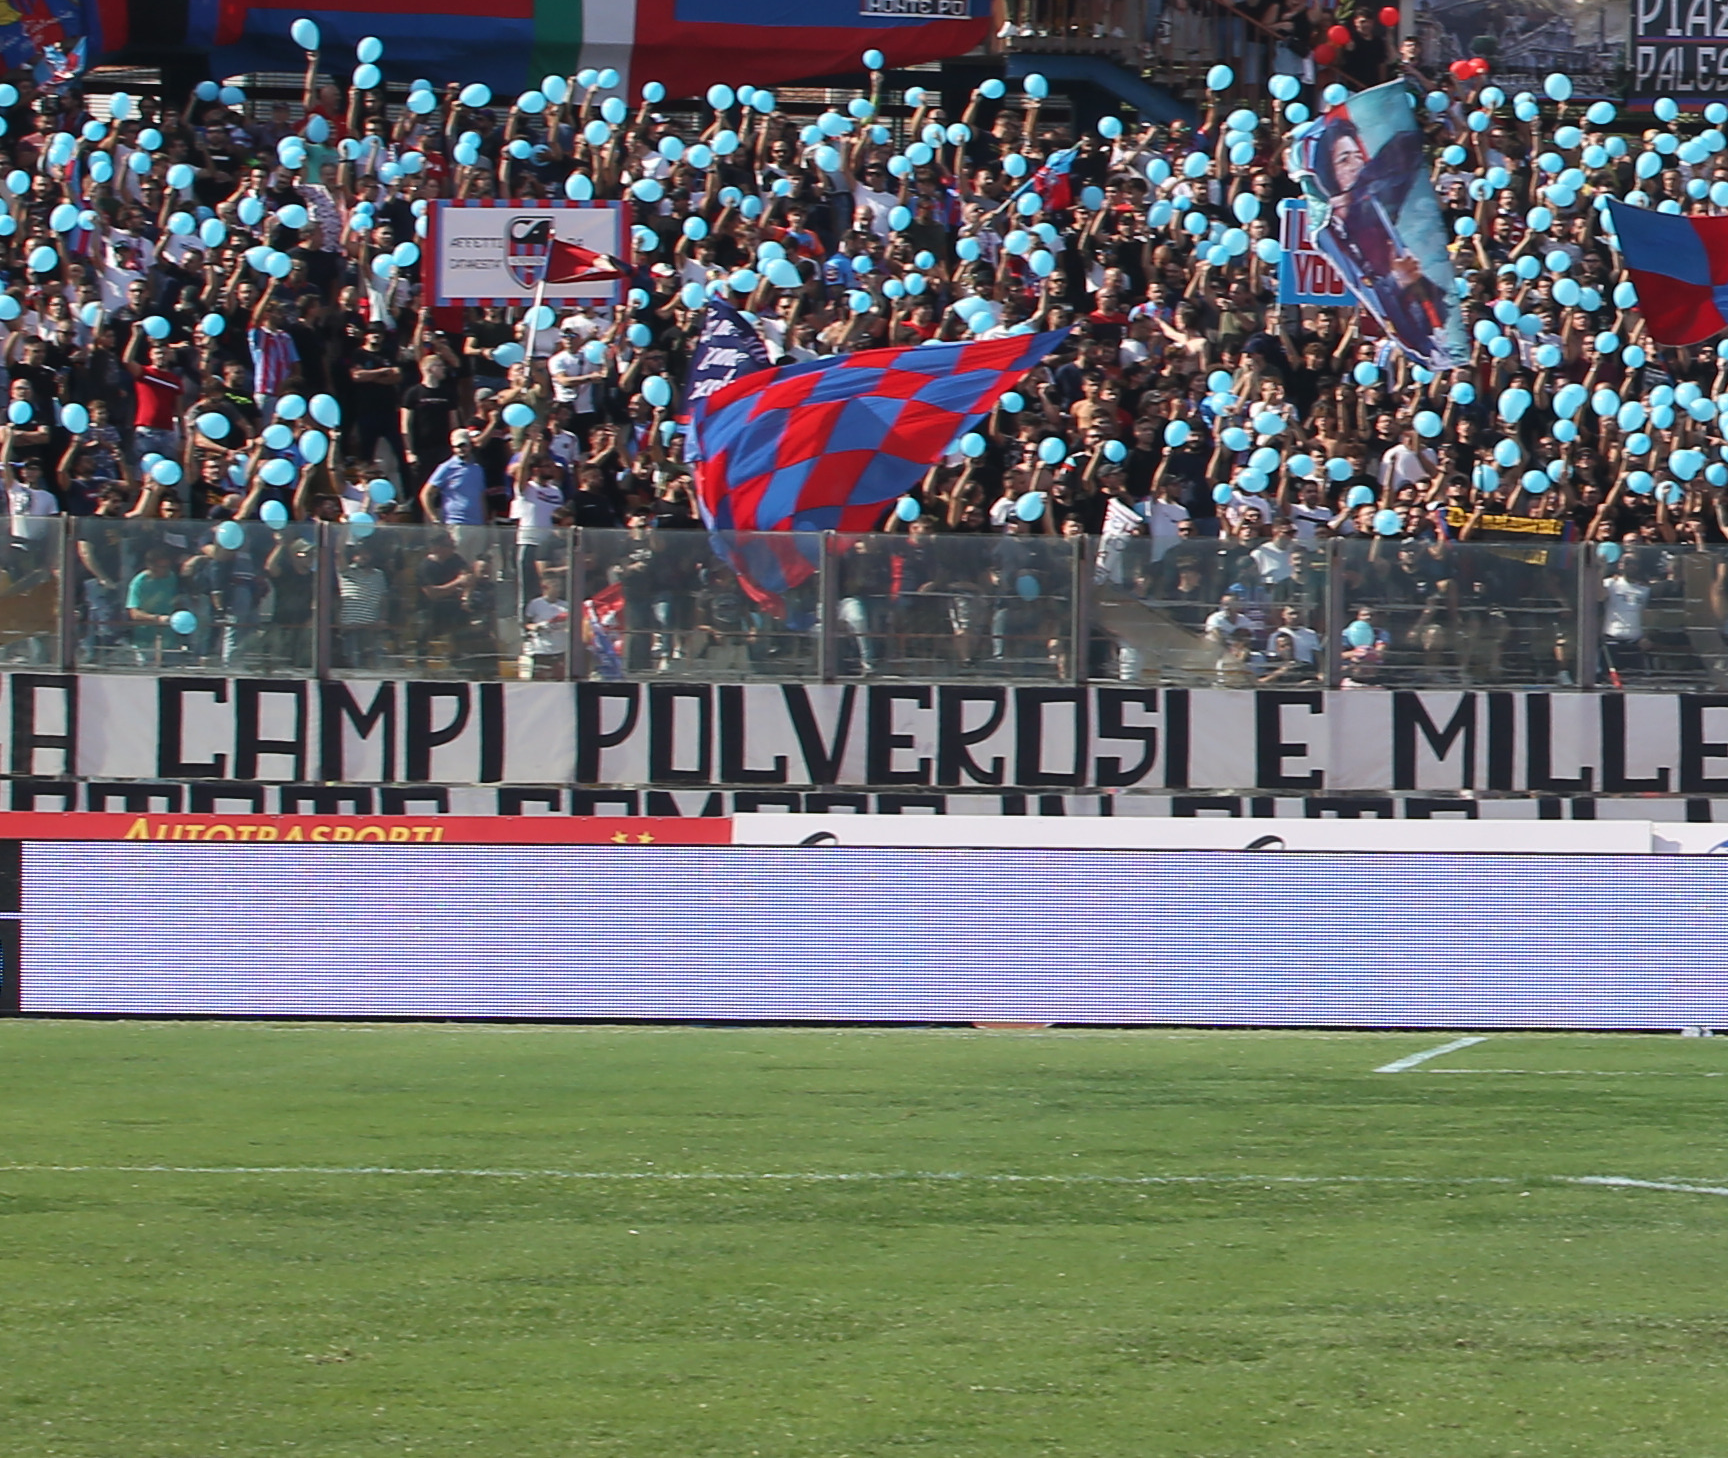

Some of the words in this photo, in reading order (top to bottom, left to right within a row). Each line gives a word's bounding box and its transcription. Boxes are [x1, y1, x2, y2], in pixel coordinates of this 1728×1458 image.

[159, 676, 505, 783] CAMPI
[576, 682, 1190, 789] POLVEROSI
[1255, 690, 1324, 791] E
